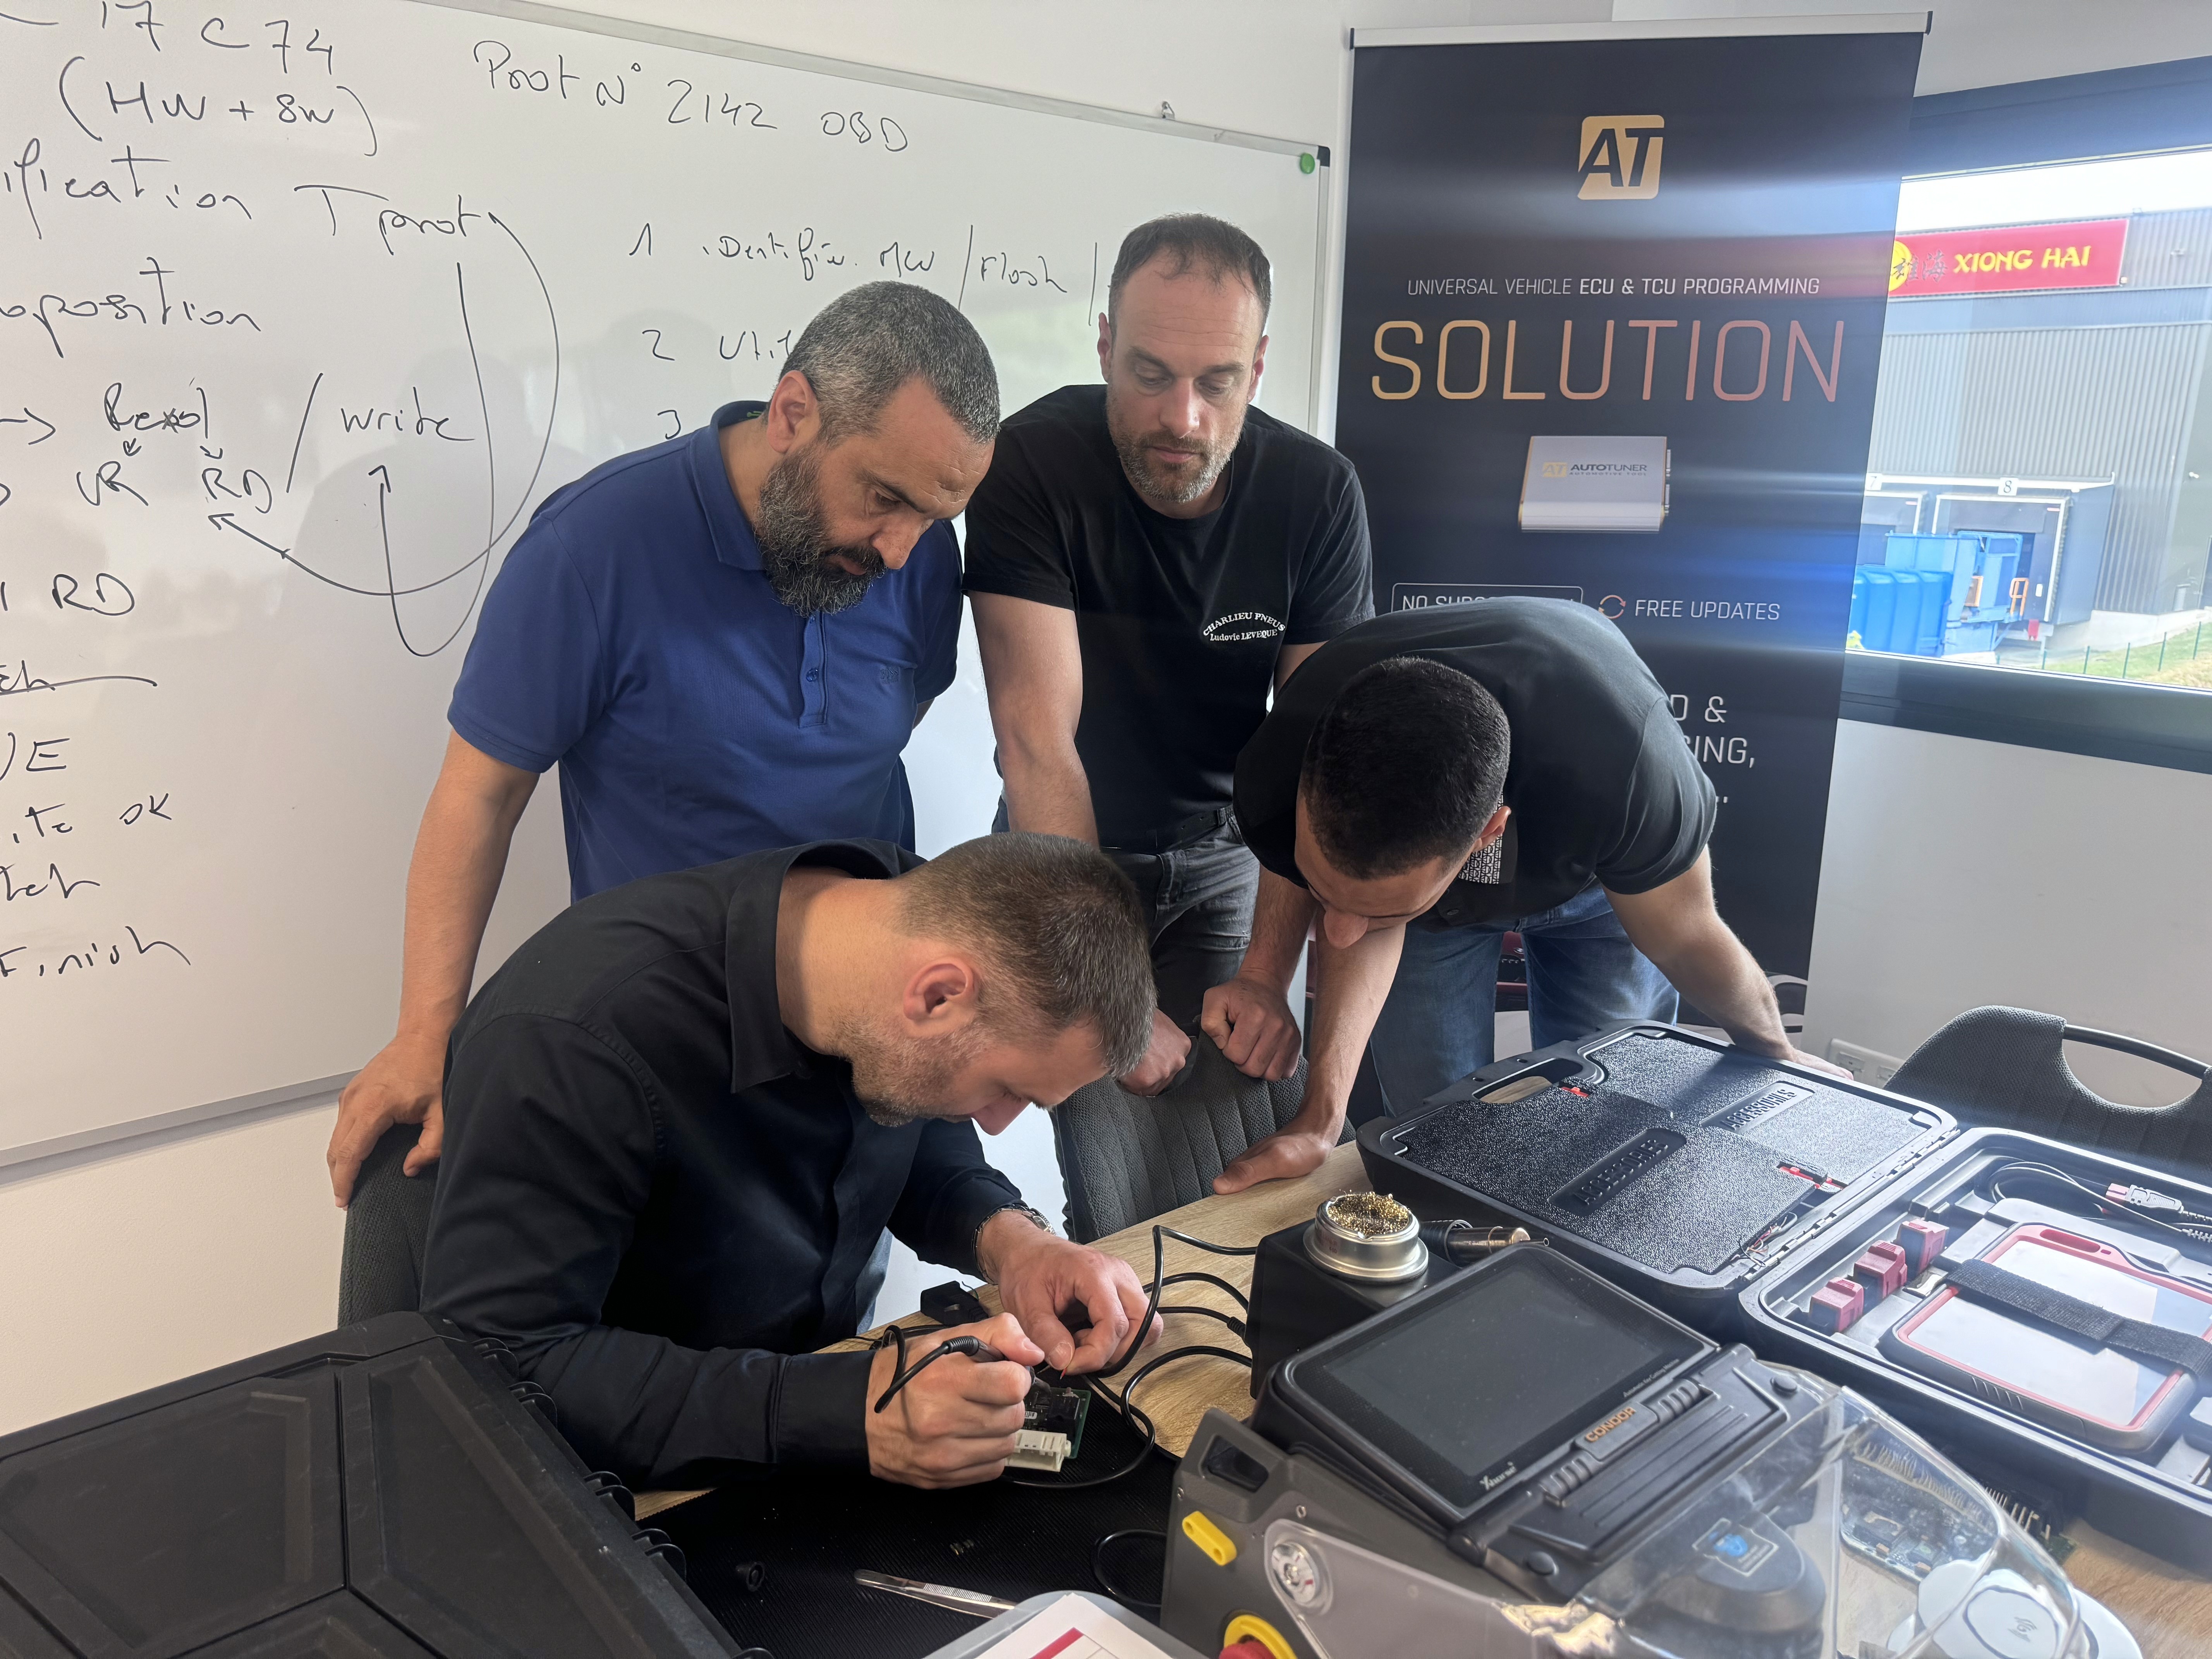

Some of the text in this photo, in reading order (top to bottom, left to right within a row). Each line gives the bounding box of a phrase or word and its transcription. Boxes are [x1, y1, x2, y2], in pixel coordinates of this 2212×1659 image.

[667, 79, 778, 129] 2142
[821, 111, 908, 152] OBD
[1578, 126, 1665, 188] AT
[1953, 245, 2091, 273] XIONG HAI
[1408, 278, 1820, 295] UNIVERSAL VEHICLE ECU & TCU PROGRAMMING
[642, 329, 675, 361] 2
[1371, 320, 1844, 402] SOLUTION
[2003, 480, 2012, 493] 8
[1203, 612, 1285, 636] CHARLIEU PNEUS
[1635, 599, 1780, 620] FREE UPDATES
[1210, 629, 1278, 641] Ludovic LEVEQUE
[1704, 696, 1728, 723] &
[1684, 735, 1755, 768] ING,
[119, 793, 172, 825] OK
[1572, 1139, 1668, 1205] ACCESSORIES
[1585, 1406, 1637, 1443] CONDOR
